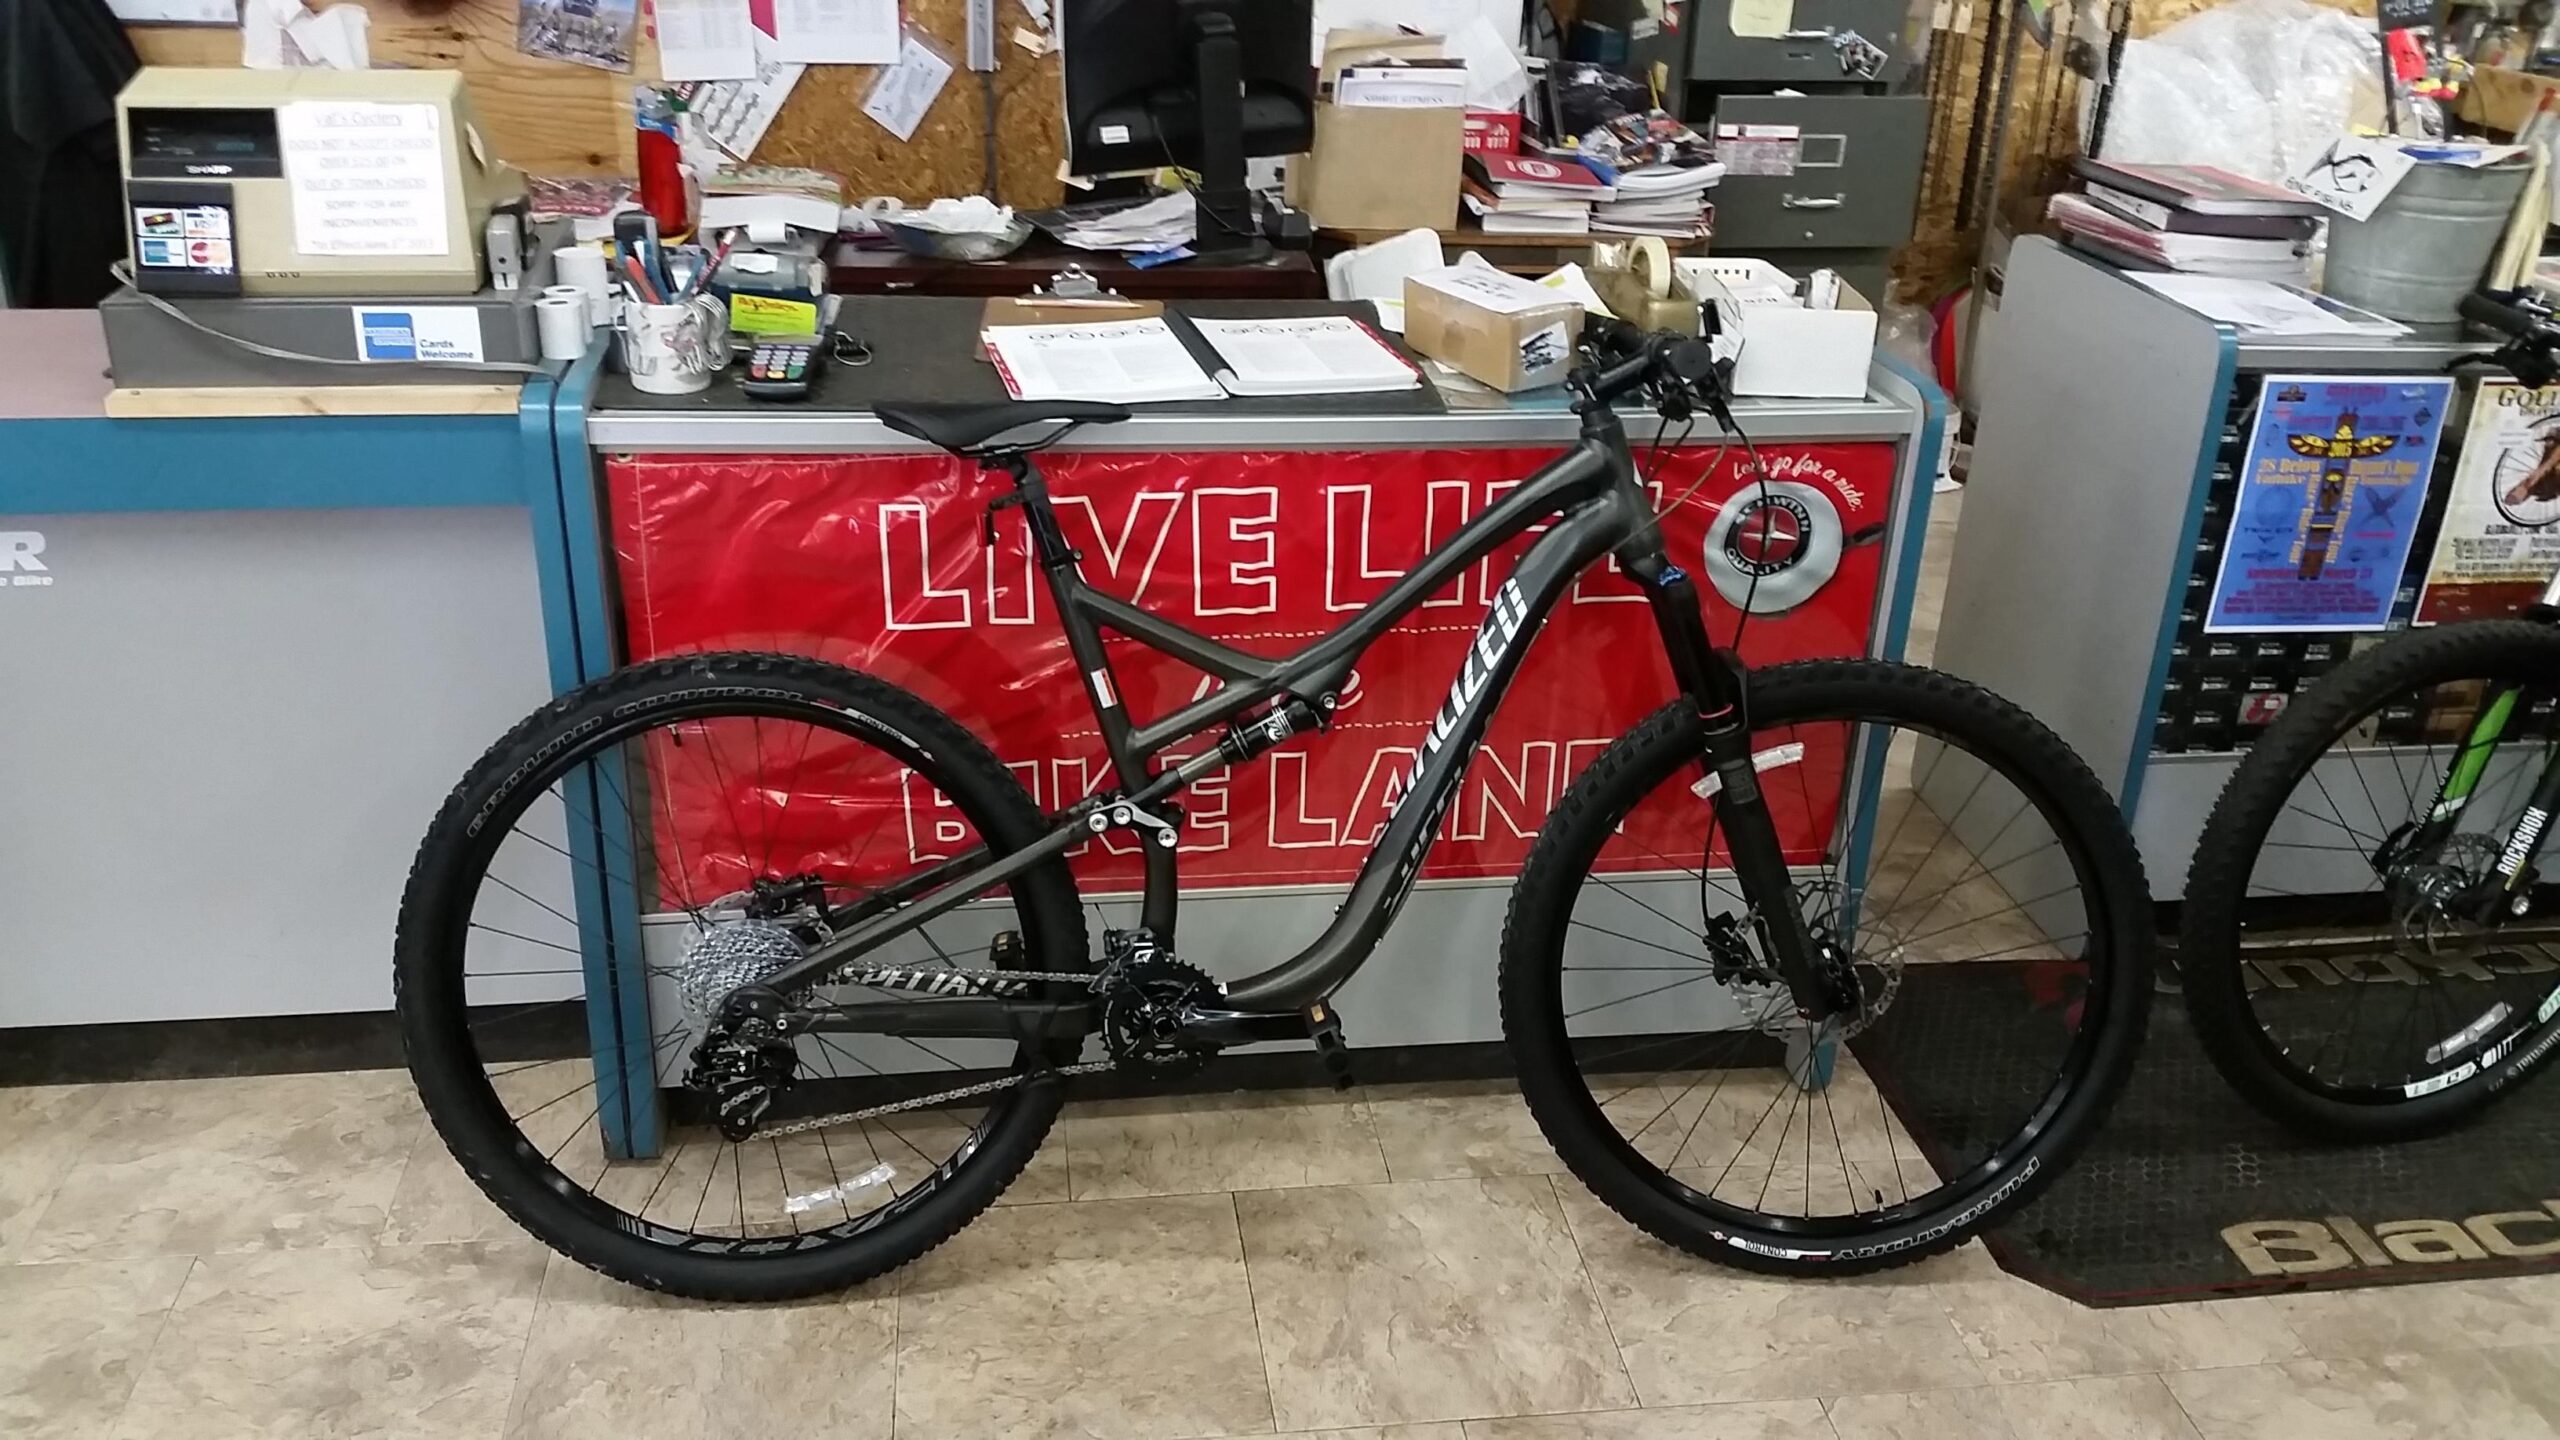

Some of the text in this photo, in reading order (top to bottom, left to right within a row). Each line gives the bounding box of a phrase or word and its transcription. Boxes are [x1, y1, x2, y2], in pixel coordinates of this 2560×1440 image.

[185, 164, 233, 175] SHARP
[420, 338, 455, 348] Cards
[421, 350, 475, 359] Welcome
[1770, 455, 1793, 479] go
[1792, 453, 1822, 478] for
[1822, 468, 1838, 482] a
[879, 486, 1279, 631] LIVE
[13, 575, 54, 586] Bike
[466, 686, 804, 839] GROUND CONTROL
[2497, 805, 2549, 877] ROCKSHOX
[1831, 1156, 2041, 1262] PURGATORY
[1745, 1239, 1788, 1257] CONTROL
[2220, 1199, 2560, 1277] Blac
